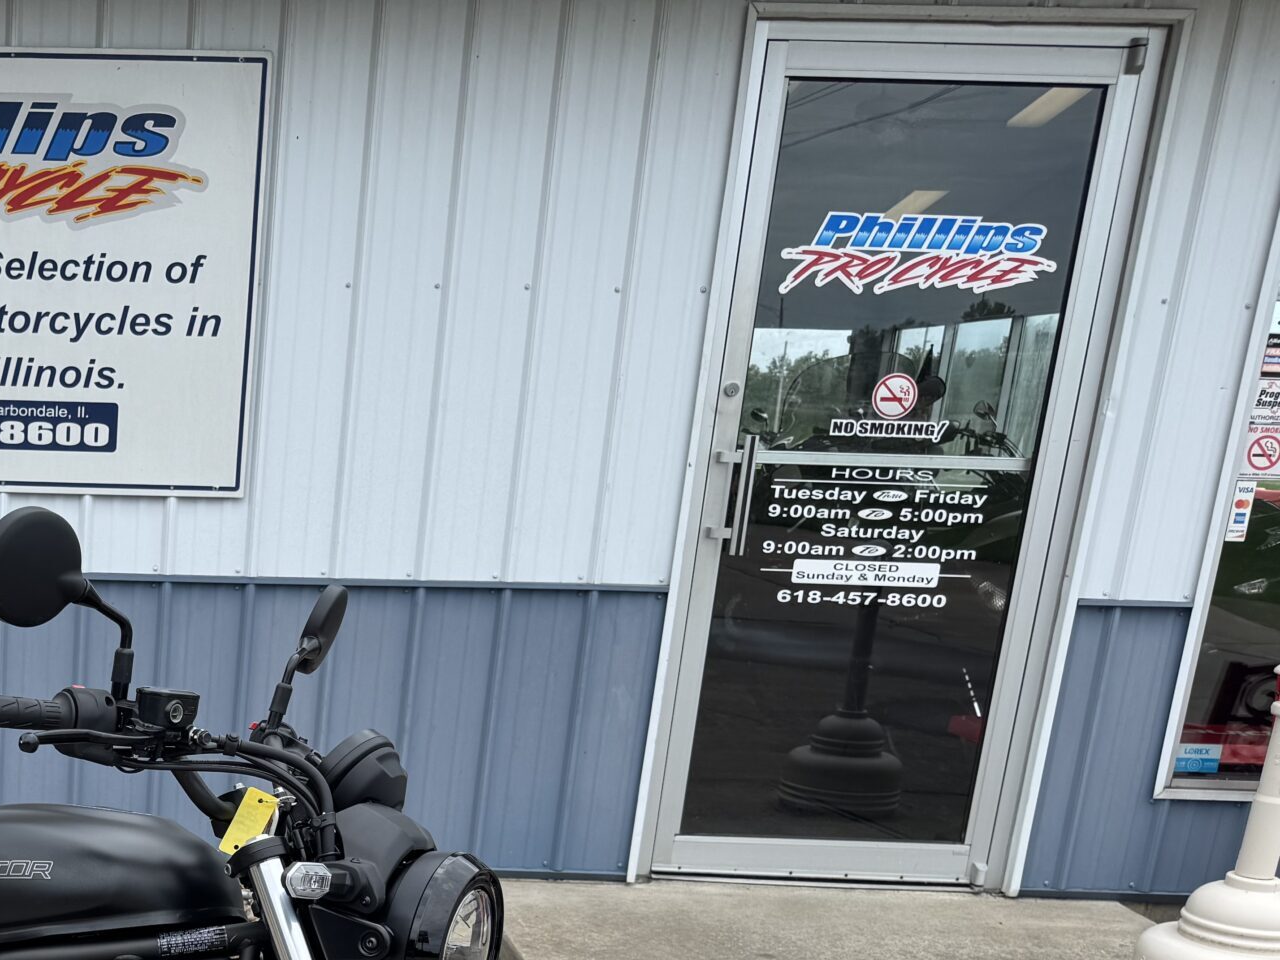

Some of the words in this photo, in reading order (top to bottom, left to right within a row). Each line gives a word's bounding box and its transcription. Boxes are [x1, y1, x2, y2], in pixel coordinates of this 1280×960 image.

[815, 213, 1044, 255] Phillips
[166, 254, 207, 284] of
[780, 248, 899, 293] PRO
[875, 254, 1055, 293] CYCLE
[186, 307, 222, 337] in
[832, 421, 855, 434] NO
[860, 421, 948, 441] SMOKING!
[831, 467, 934, 482] HOURS
[771, 485, 867, 503] Tuesday
[915, 490, 988, 508] Friday
[768, 504, 851, 519] 9:00am
[865, 509, 886, 519] To
[899, 508, 984, 525] 5:00pm
[820, 523, 925, 542] Saturday
[762, 541, 845, 556] 9:00am
[859, 546, 880, 556] To
[892, 545, 977, 562] 2:00pm
[796, 570, 853, 582] Sunday
[874, 574, 934, 585] Monday
[833, 563, 899, 573] CLOSED
[777, 589, 947, 608] 618-457-8600
